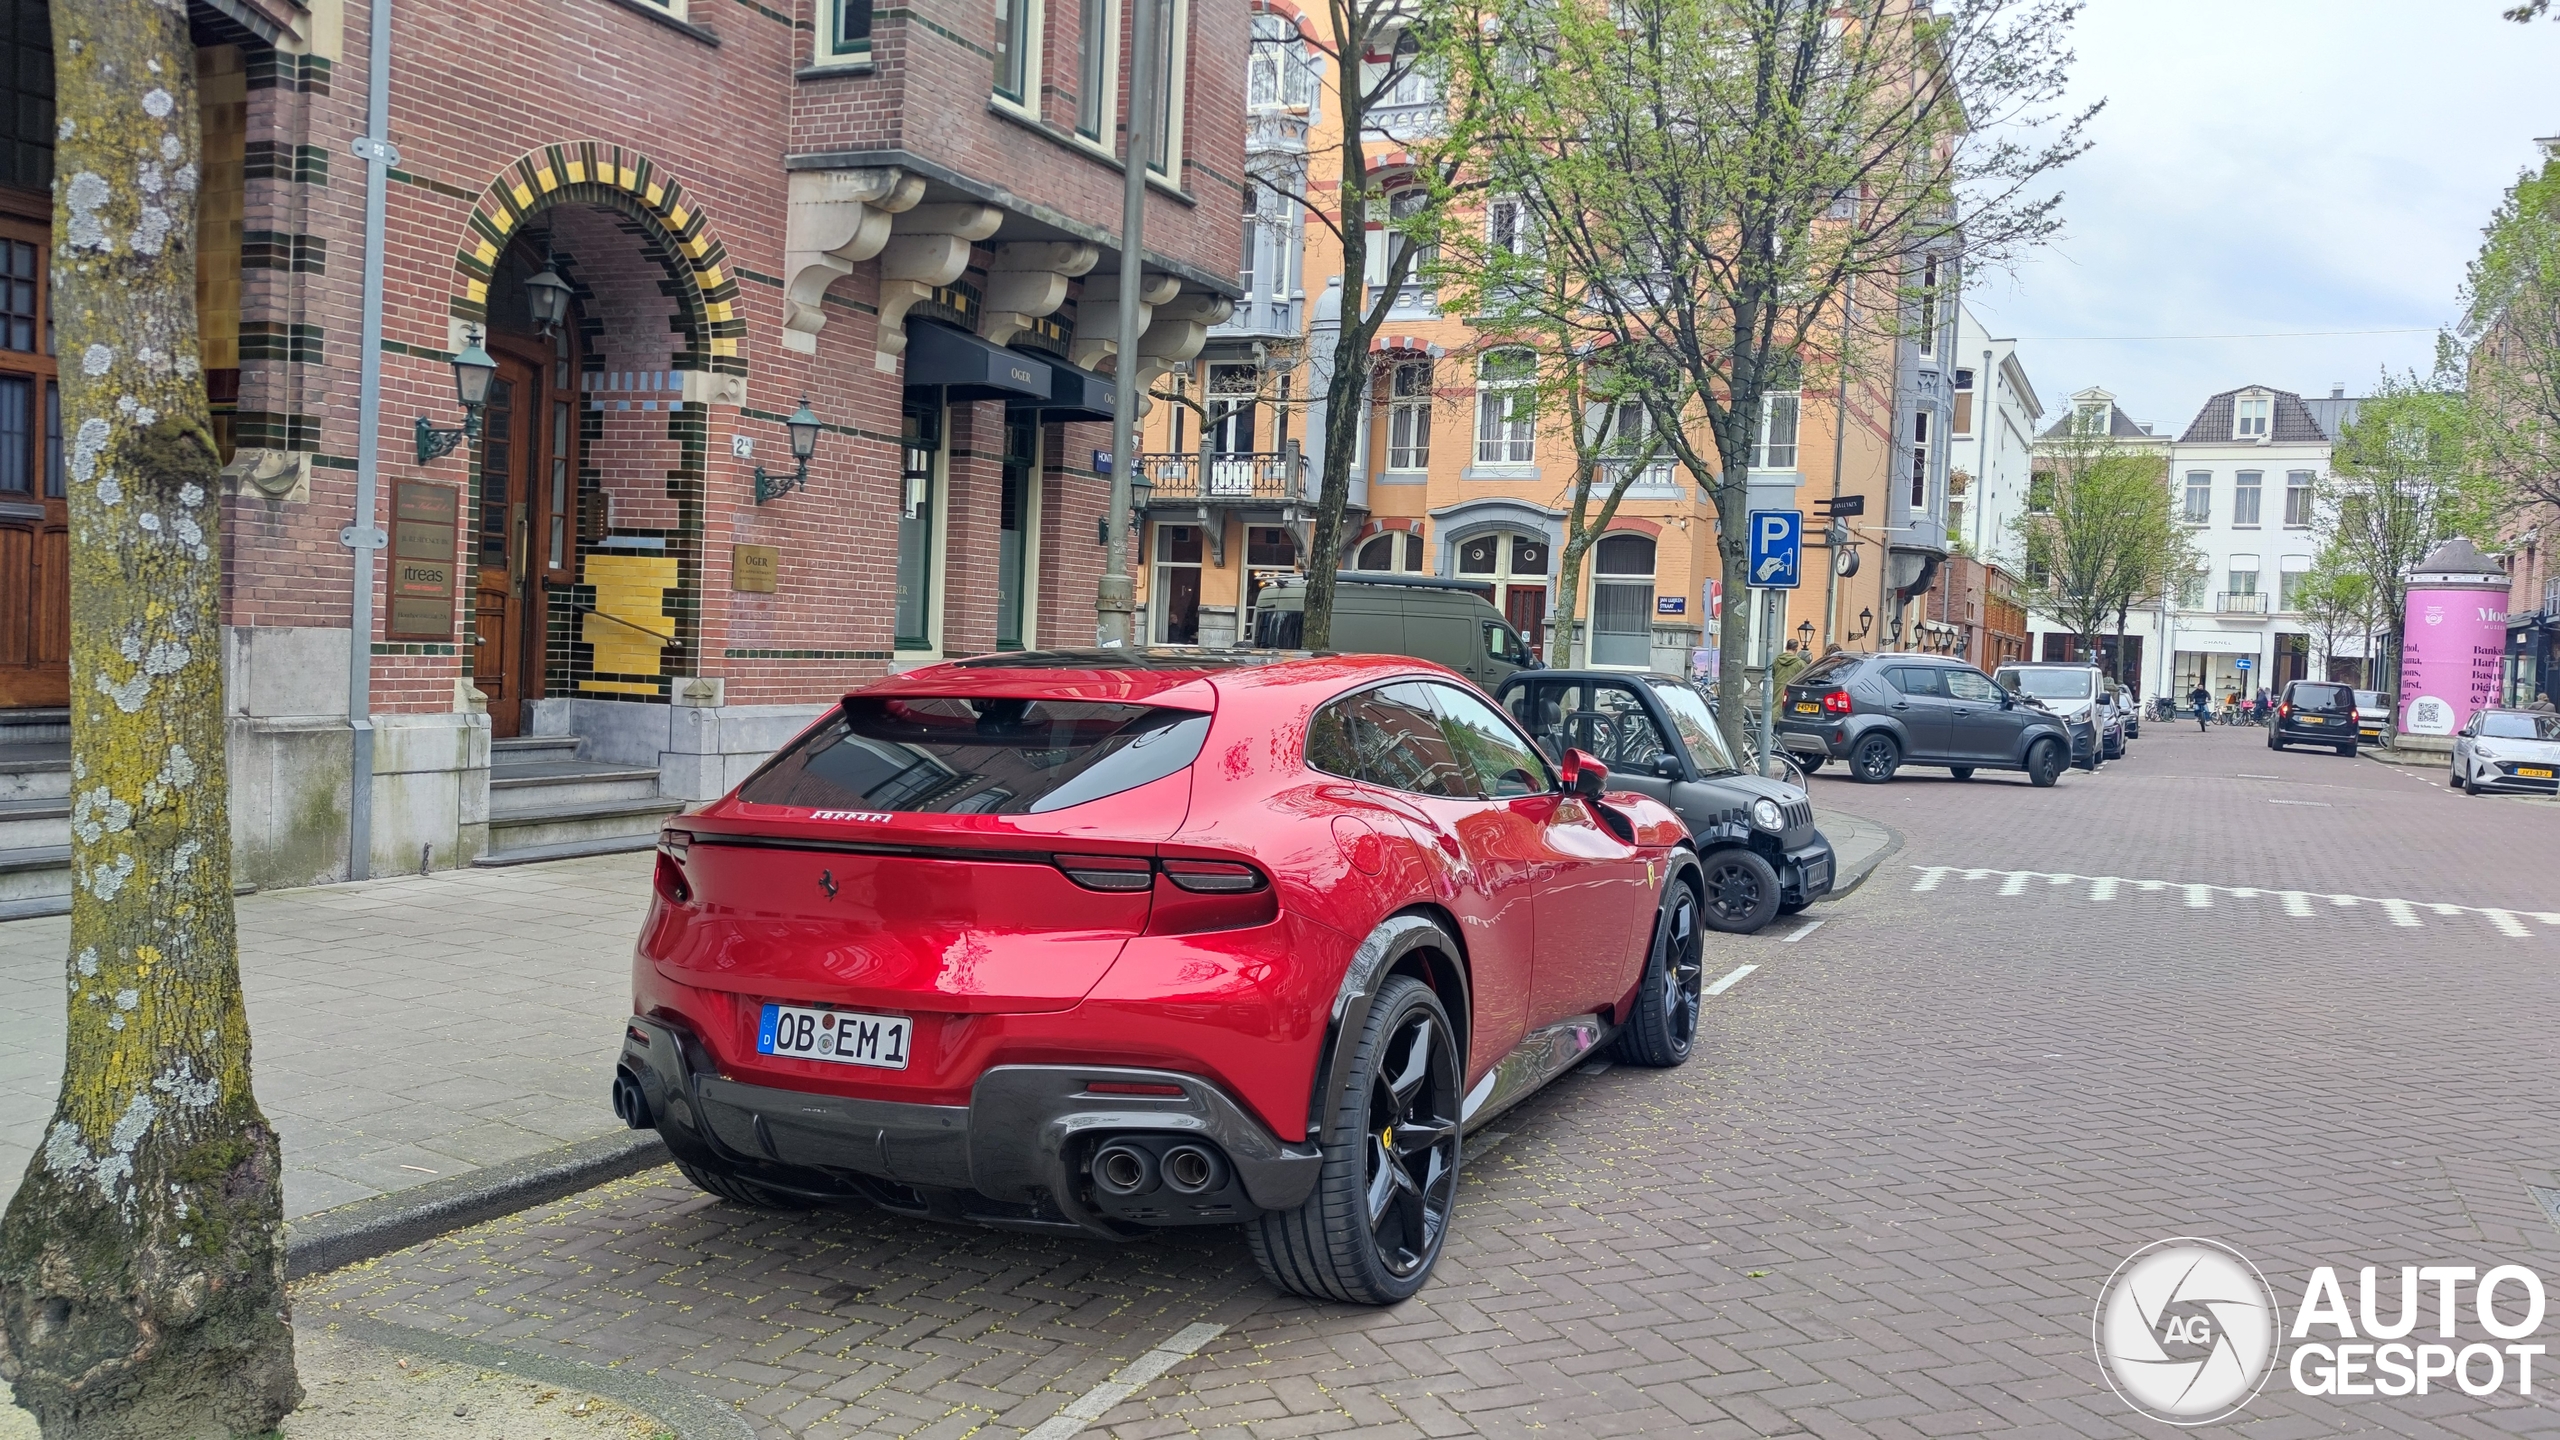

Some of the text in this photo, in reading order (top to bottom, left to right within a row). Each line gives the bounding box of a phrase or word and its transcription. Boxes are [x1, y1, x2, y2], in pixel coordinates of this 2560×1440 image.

[1011, 367, 1031, 384] OGER
[1104, 392, 1116, 404] OG
[1761, 517, 1790, 554] P
[745, 555, 768, 567] OGER
[404, 565, 443, 582] itreas
[2470, 695, 2480, 703] &
[763, 1012, 904, 1063] D OB EM 1
